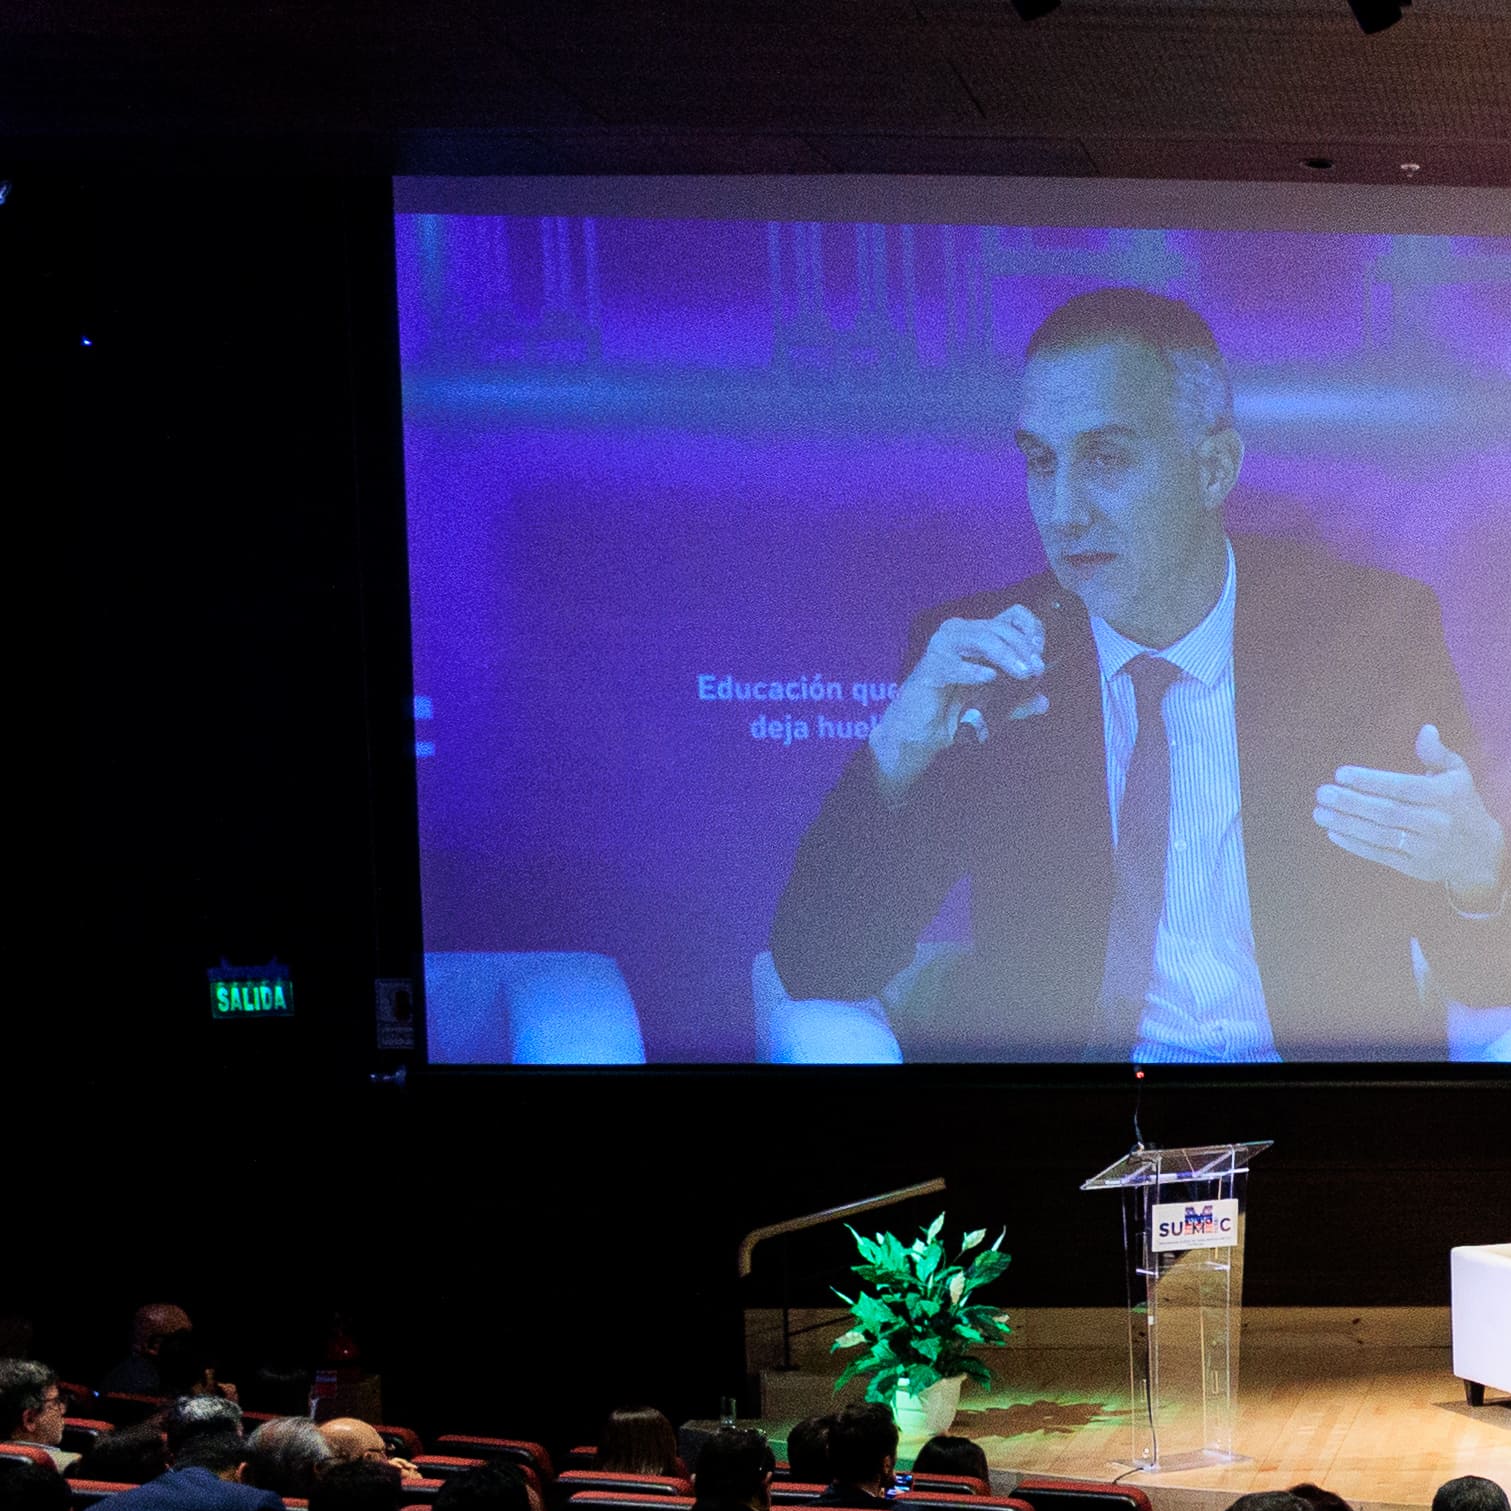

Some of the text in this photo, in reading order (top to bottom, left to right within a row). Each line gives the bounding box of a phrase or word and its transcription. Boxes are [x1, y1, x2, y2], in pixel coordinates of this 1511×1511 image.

[698, 673, 843, 701] Educación
[750, 716, 810, 747] deja
[216, 985, 287, 1012] SALIDA
